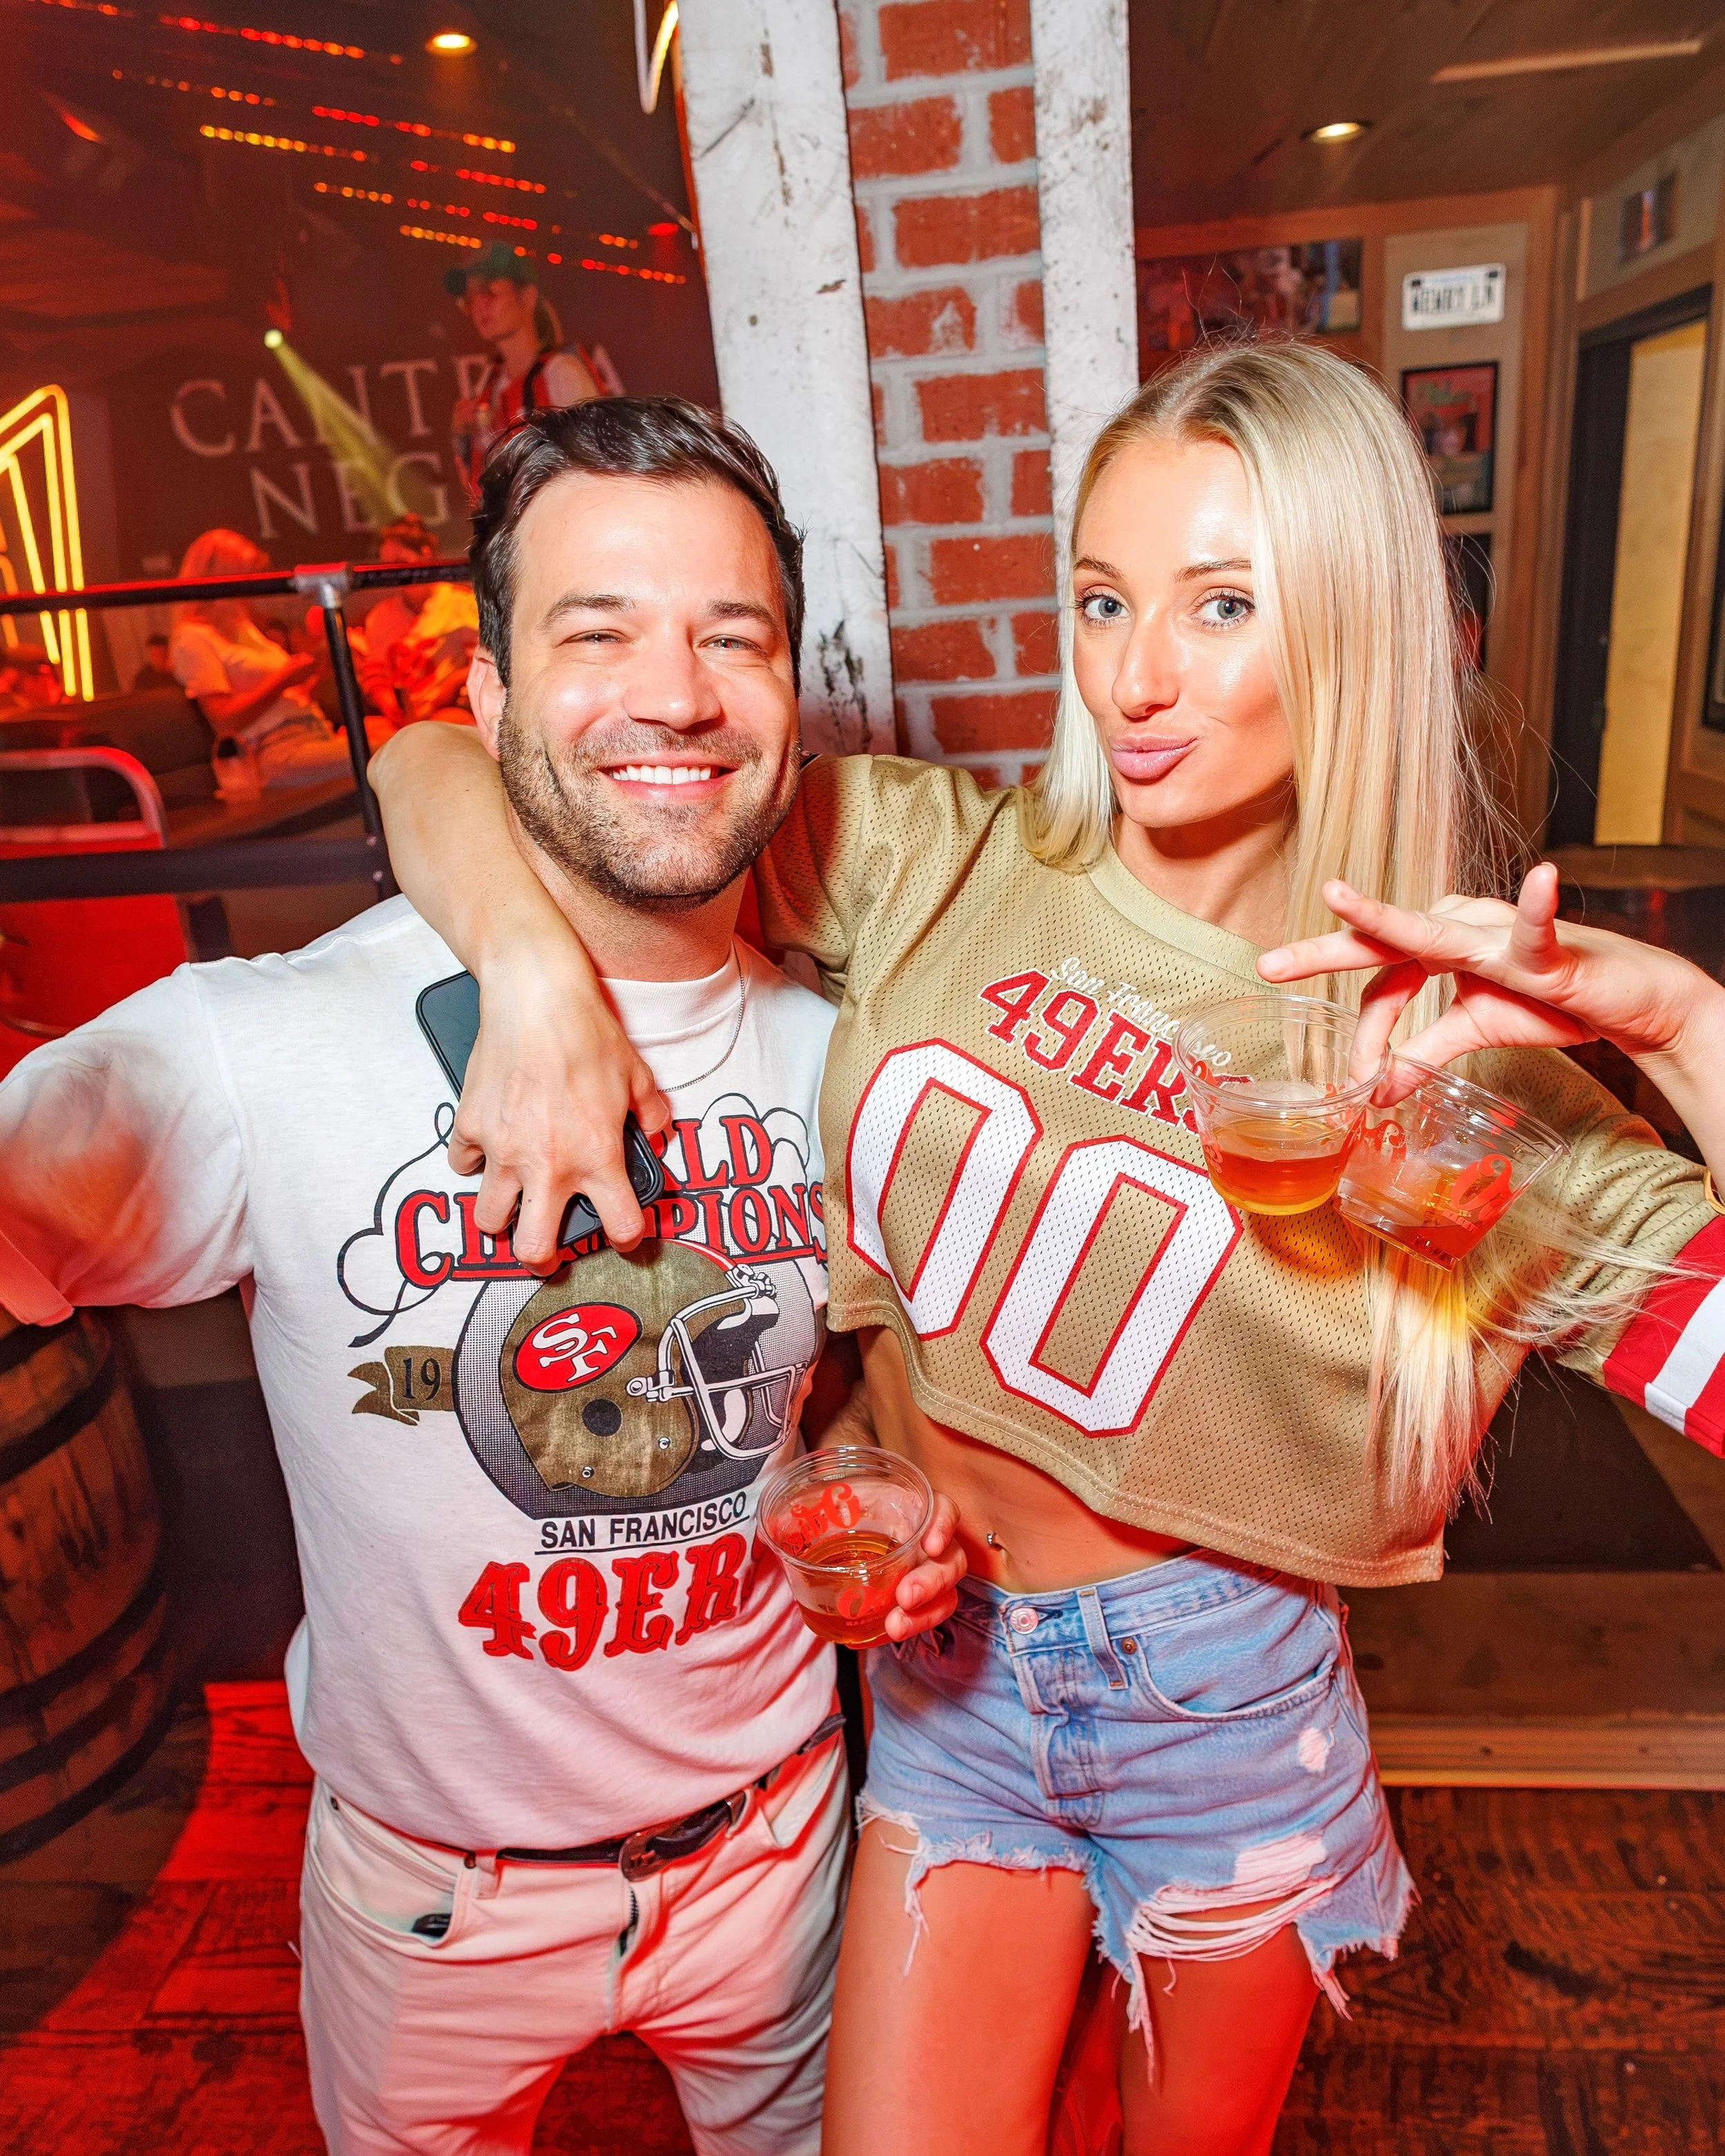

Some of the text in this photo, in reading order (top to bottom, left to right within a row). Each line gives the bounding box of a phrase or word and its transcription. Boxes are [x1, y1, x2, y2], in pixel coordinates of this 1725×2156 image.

[1049, 956, 1105, 996] San
[846, 1037, 1244, 1439] 00
[400, 1356, 442, 1400] 19
[531, 1312, 618, 1383] SF
[540, 1518, 597, 1549] SAN
[609, 1491, 747, 1545] FRANCISCO
[457, 1532, 758, 1673] 49ER
